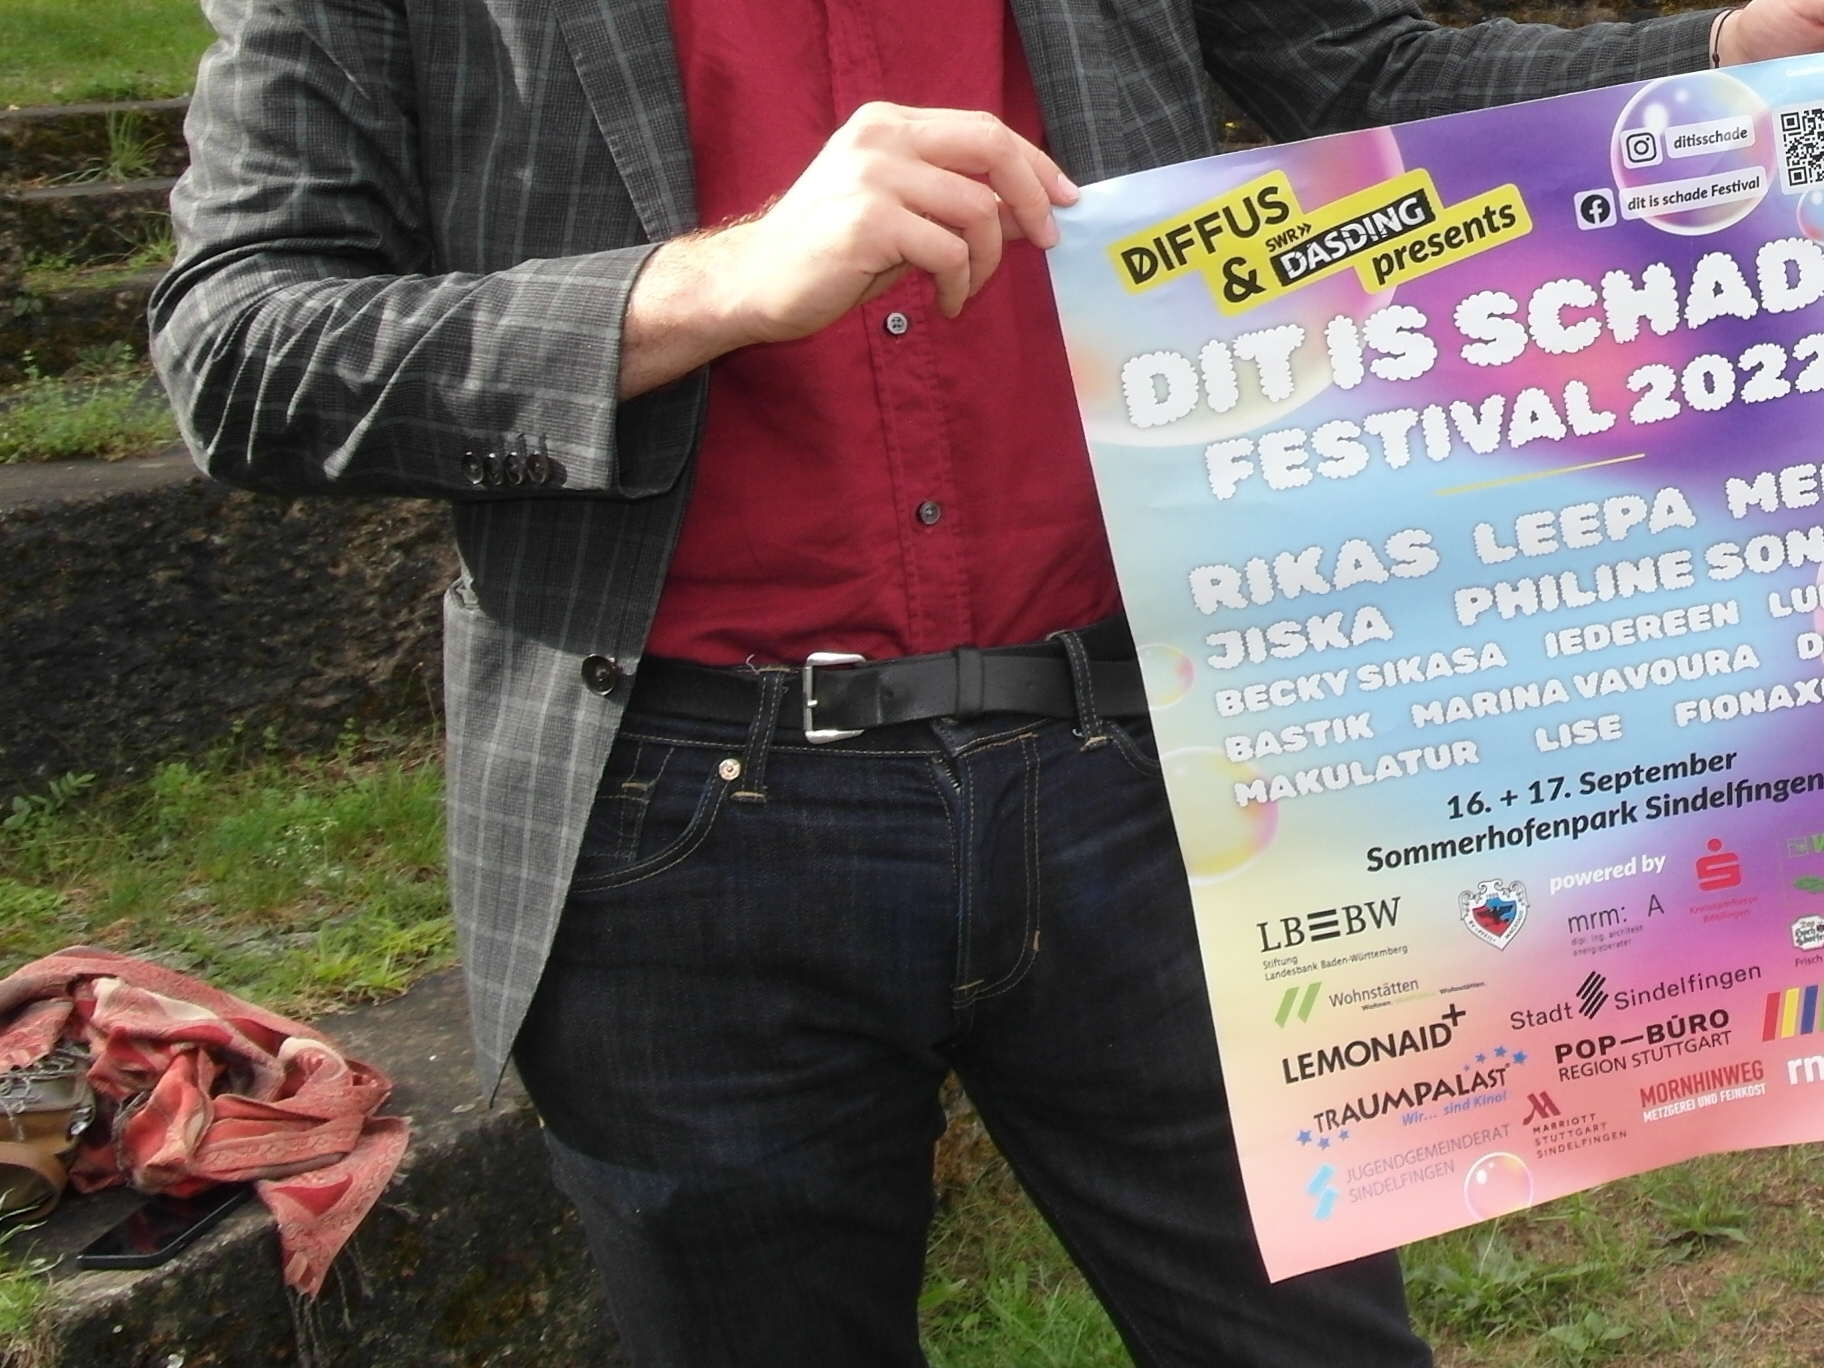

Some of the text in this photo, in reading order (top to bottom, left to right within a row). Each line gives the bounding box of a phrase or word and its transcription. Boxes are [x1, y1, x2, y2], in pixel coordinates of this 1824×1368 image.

[1673, 127, 1748, 150] ditisschade
[1627, 176, 1760, 212] dit is schade Festival
[1120, 186, 1291, 285] DIFFUS
[1279, 196, 1426, 281] DASDING
[1372, 201, 1517, 285] presents
[1222, 256, 1266, 303] &
[1121, 323, 1306, 429] DIT
[1324, 305, 1438, 390] IS
[1205, 380, 1616, 500] FESTIVAL
[1188, 528, 1440, 615] RIKAS
[1473, 487, 1697, 564] LEEPA
[1205, 606, 1394, 670] JISKA
[1454, 549, 1695, 626] PHILINE
[1215, 668, 1349, 717] BECKY
[1356, 641, 1507, 691] SIKASA
[1544, 599, 1740, 658] IEDEREEN
[1224, 712, 1374, 763] BASTIK
[1411, 678, 1570, 728] MARINA
[1573, 643, 1760, 699] VAVOURA
[1233, 740, 1480, 807] MAKULATUR
[1535, 713, 1623, 752] LISE
[1446, 747, 1738, 820] 16. + 17. September
[1366, 800, 1638, 873] Sommerhofenpark
[1549, 854, 1666, 895] powered by
[1262, 955, 1298, 970] Stiftung
[1264, 945, 1408, 981] Landesbank Baden-Württemberg
[1795, 954, 1823, 968] Frisch
[1328, 979, 1419, 1007] Wohnstätten
[1510, 965, 1762, 1030] Stadt Sindelfingen
[1558, 1030, 1732, 1082] REGION STUTTGART
[1313, 1066, 1508, 1133] TRAUMPALAST
[1443, 1101, 1470, 1116] sind
[1639, 1060, 1765, 1108] MORNHINWEG
[1643, 1083, 1767, 1123] METZGEREI UND FEINKOST
[1532, 1113, 1596, 1134] MARRIOTT
[1534, 1122, 1608, 1147] STUTTGART
[1536, 1130, 1628, 1160] SINDELFINGEN
[1346, 1124, 1511, 1184] JUGENDGEMEINDERAT
[1348, 1160, 1456, 1203] SINDELFINGEN
